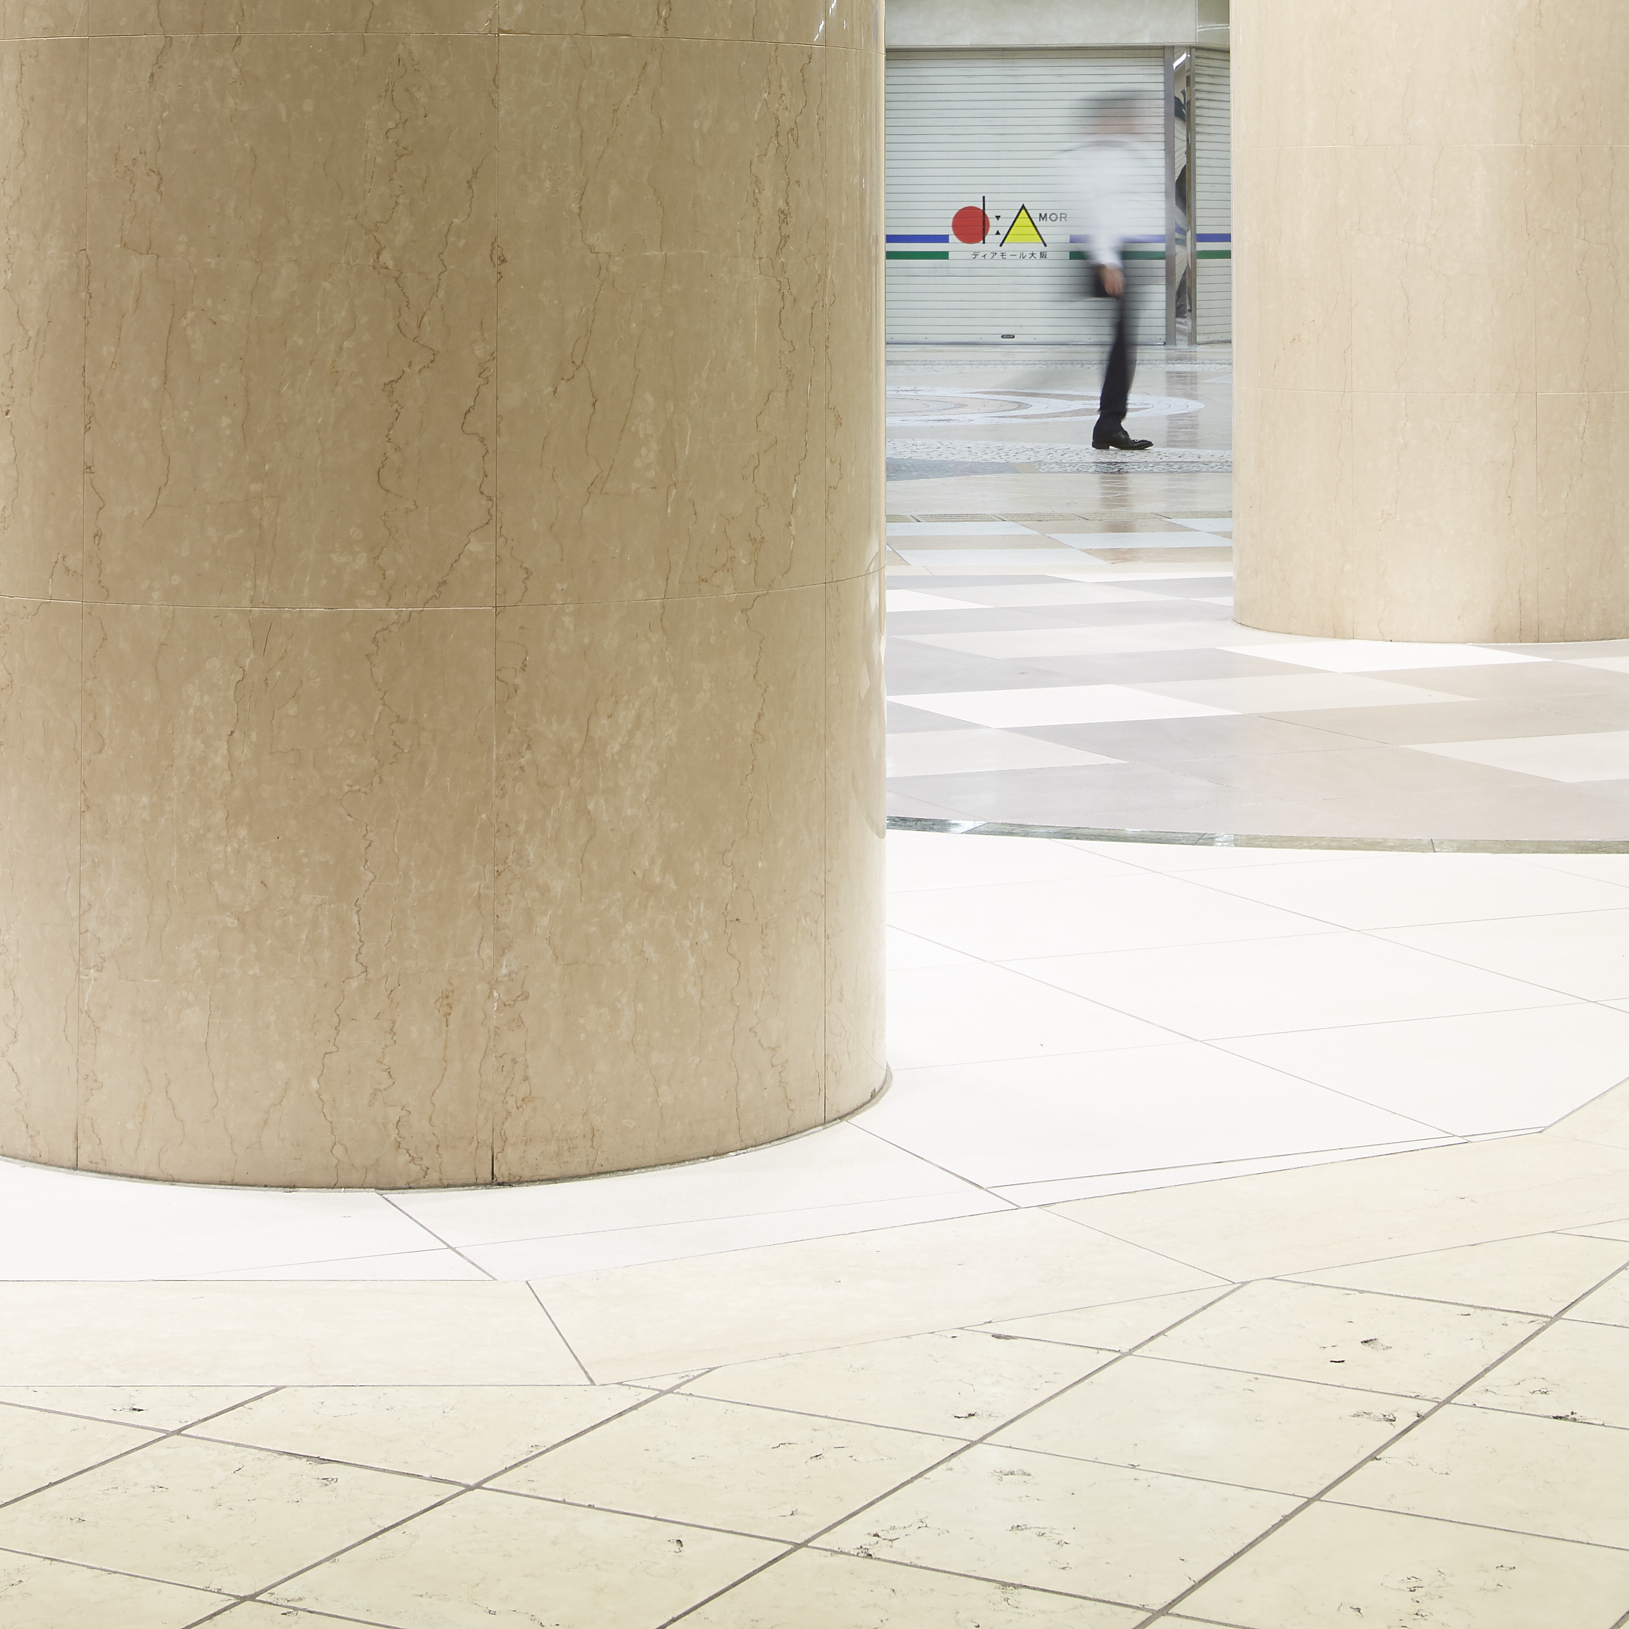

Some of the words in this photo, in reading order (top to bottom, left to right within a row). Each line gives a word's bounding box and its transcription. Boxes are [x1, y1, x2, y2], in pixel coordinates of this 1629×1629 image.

[971, 251, 1048, 260] ディアモール大阪
